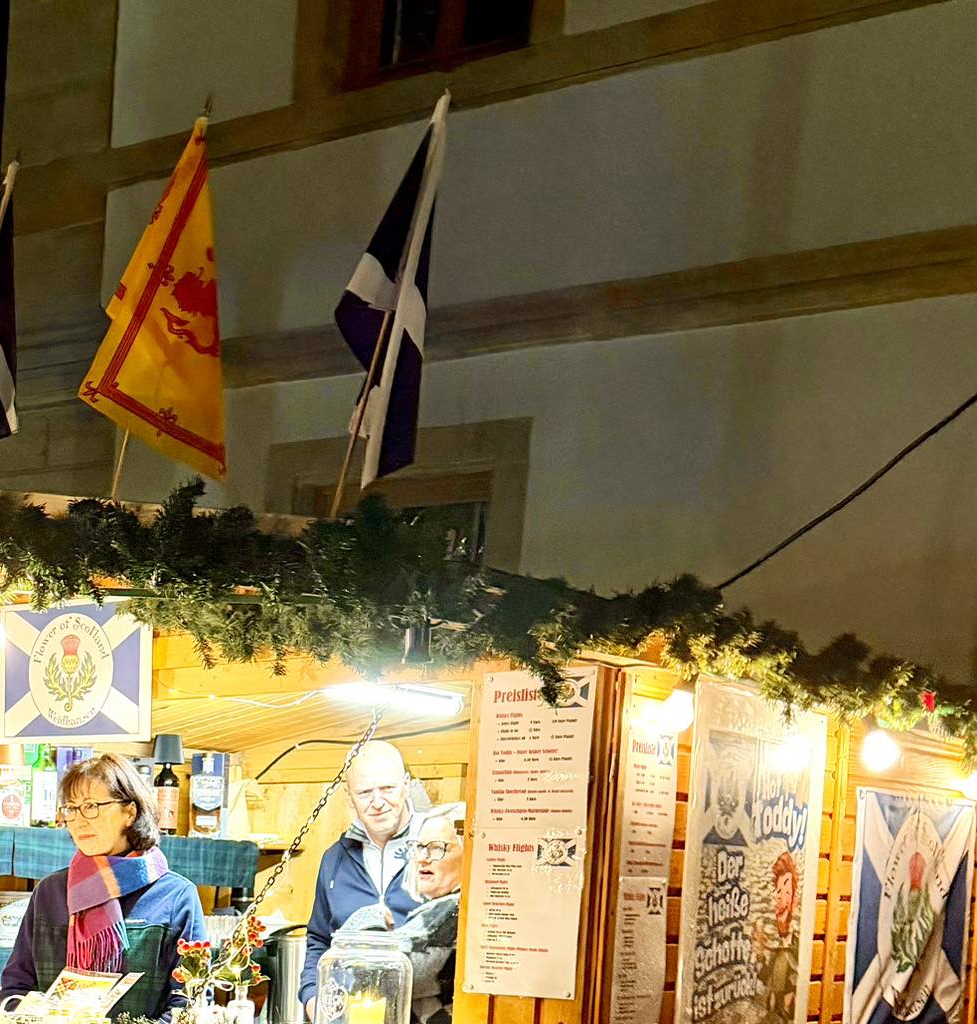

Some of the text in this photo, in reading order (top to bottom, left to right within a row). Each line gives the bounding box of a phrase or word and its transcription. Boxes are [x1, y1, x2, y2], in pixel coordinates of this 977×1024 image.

[33, 626, 57, 664] Flower
[72, 616, 110, 660] Scotland
[751, 794, 809, 850] Toddy!
[488, 843, 535, 853] Whisky Flights
[717, 850, 744, 882] Der
[708, 886, 749, 927] heiße
